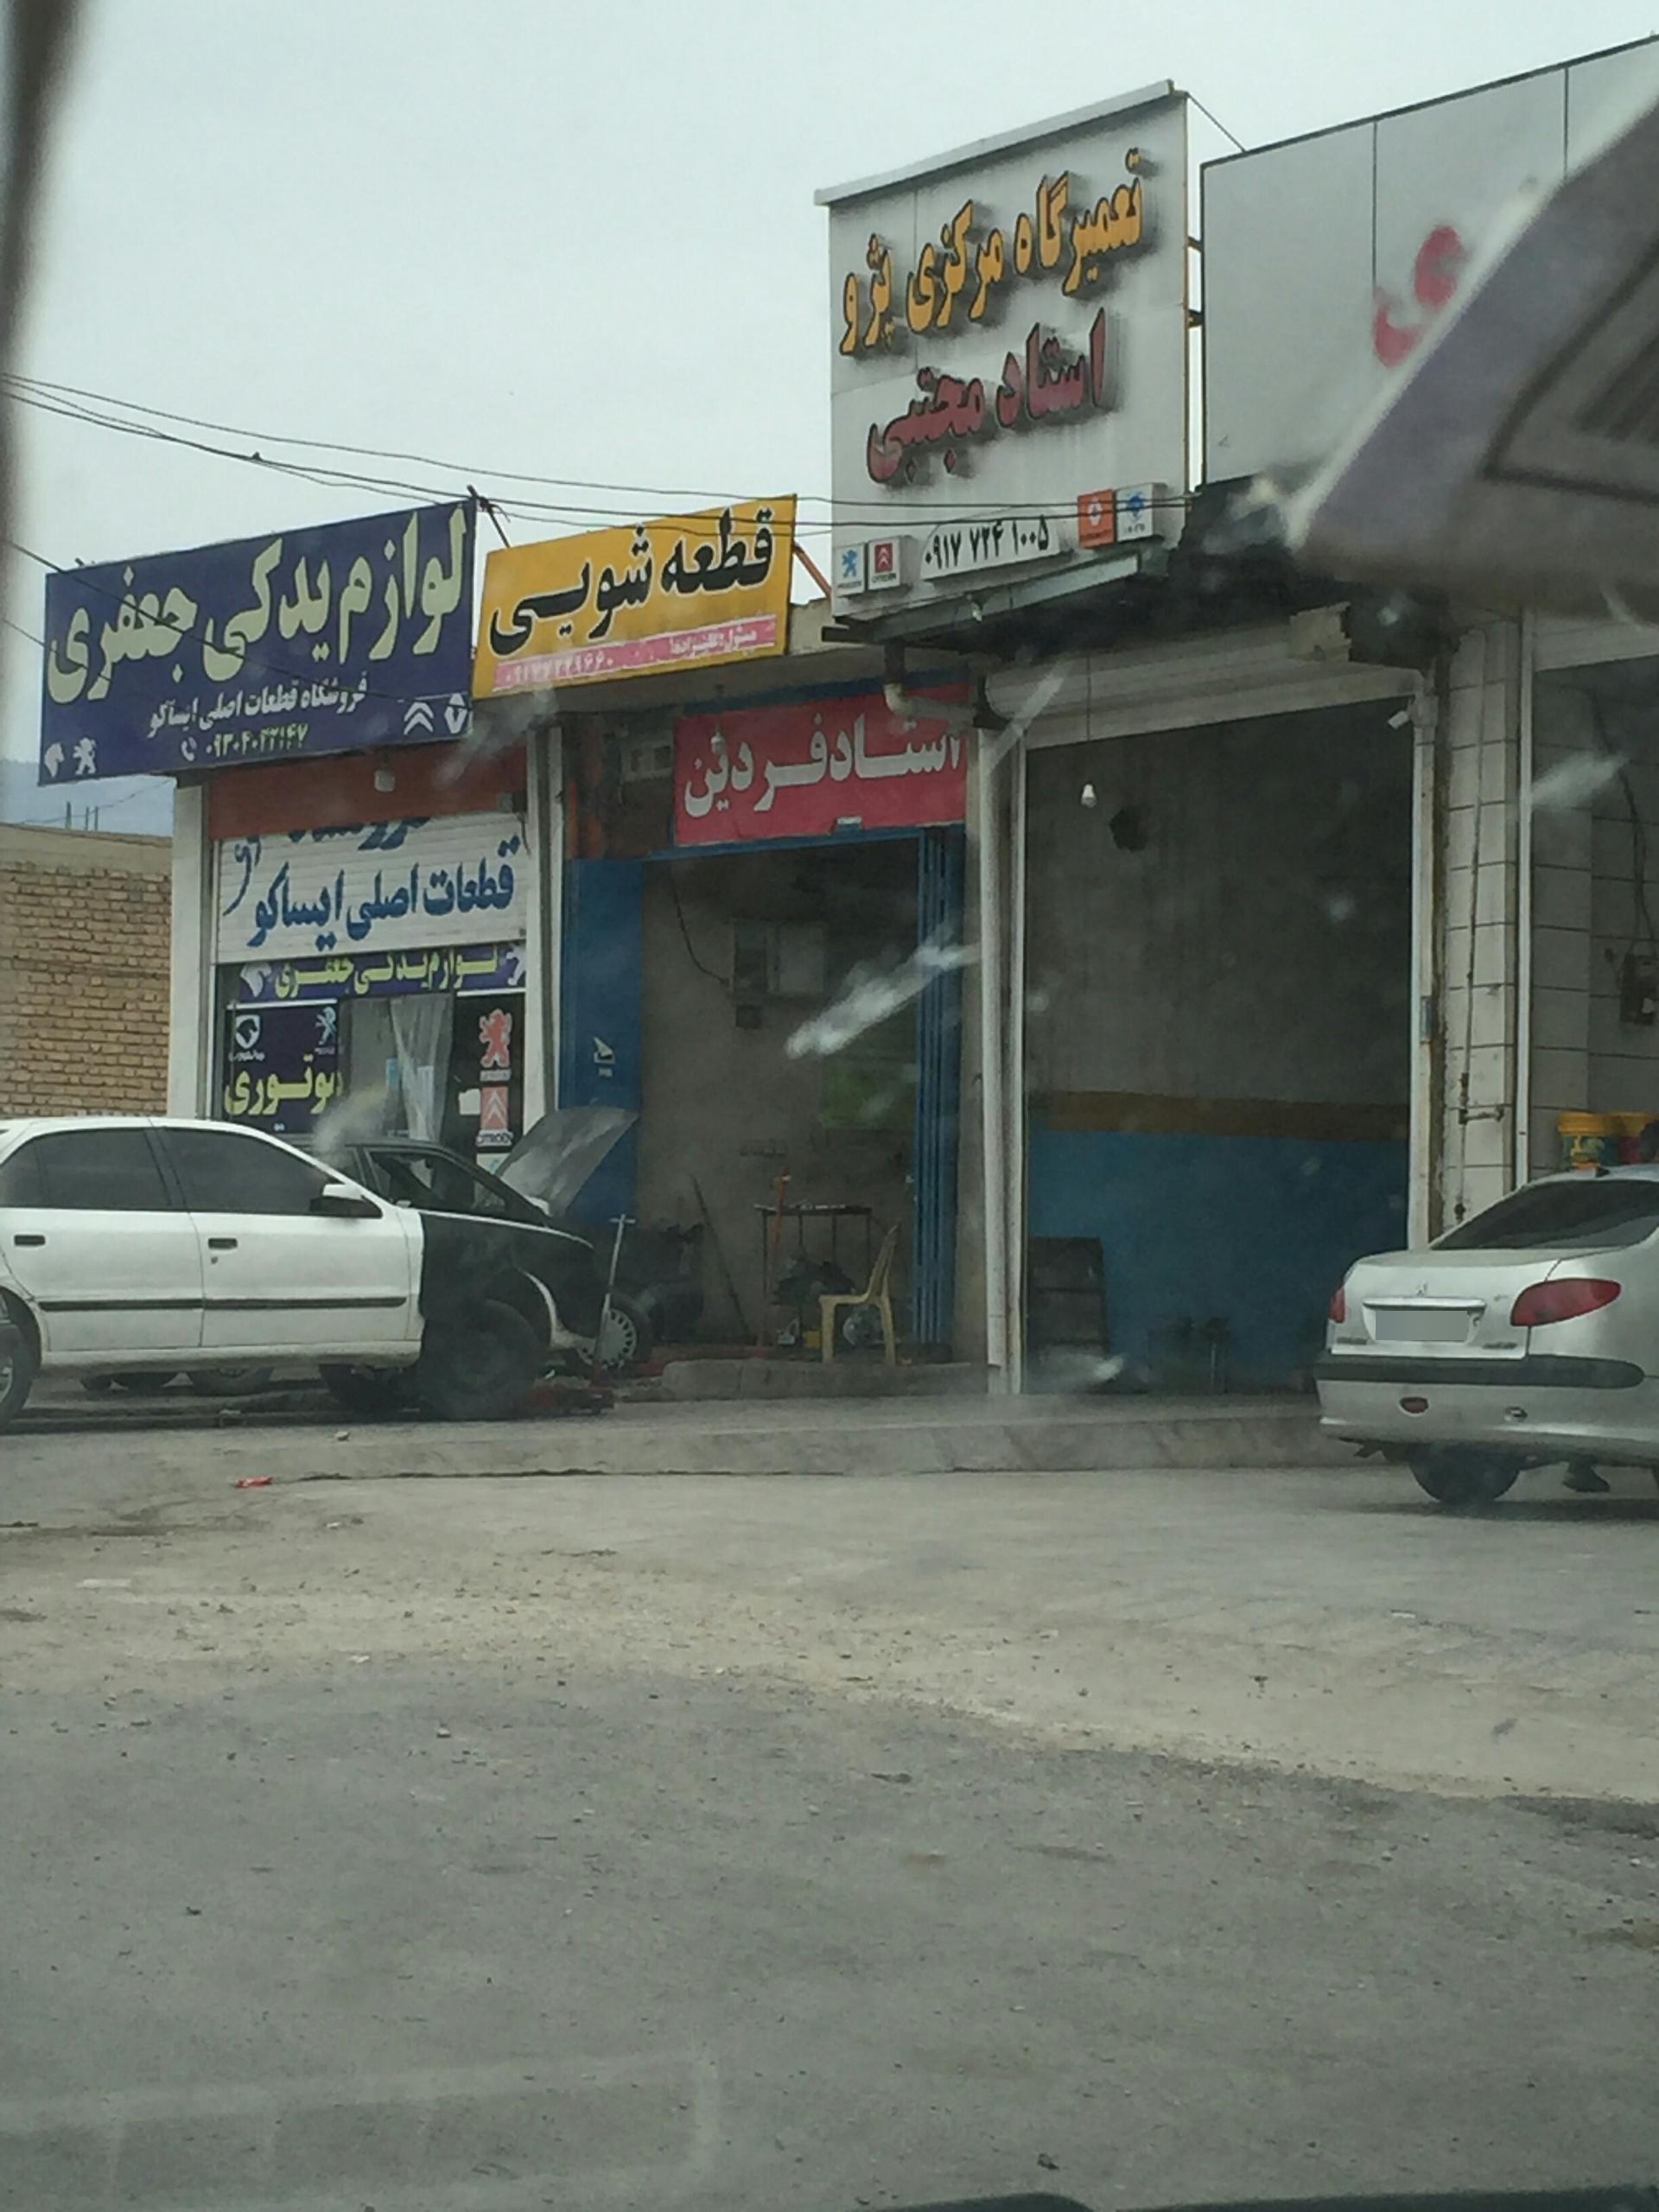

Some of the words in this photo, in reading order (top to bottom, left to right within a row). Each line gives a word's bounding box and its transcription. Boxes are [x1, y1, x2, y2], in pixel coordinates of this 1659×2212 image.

[906, 198, 1006, 334] مرکزی
[1013, 147, 1145, 297] تعمیرگاه
[839, 232, 895, 357] پژو
[995, 307, 1107, 429] استاد
[867, 365, 986, 485] مجتبی
[340, 502, 467, 664] لوازم
[488, 522, 656, 657] شویی
[659, 506, 775, 594] قطعه
[47, 566, 199, 704] جعفری
[202, 537, 332, 682] یدکی
[198, 690, 244, 731] اصلی
[244, 679, 299, 717] قطعات
[300, 671, 368, 715] فروشگاه
[830, 713, 961, 780] استاد
[683, 713, 829, 818] فردین
[245, 860, 345, 952] ایساکو
[346, 861, 420, 941] اصلی
[422, 831, 522, 917] قطعات
